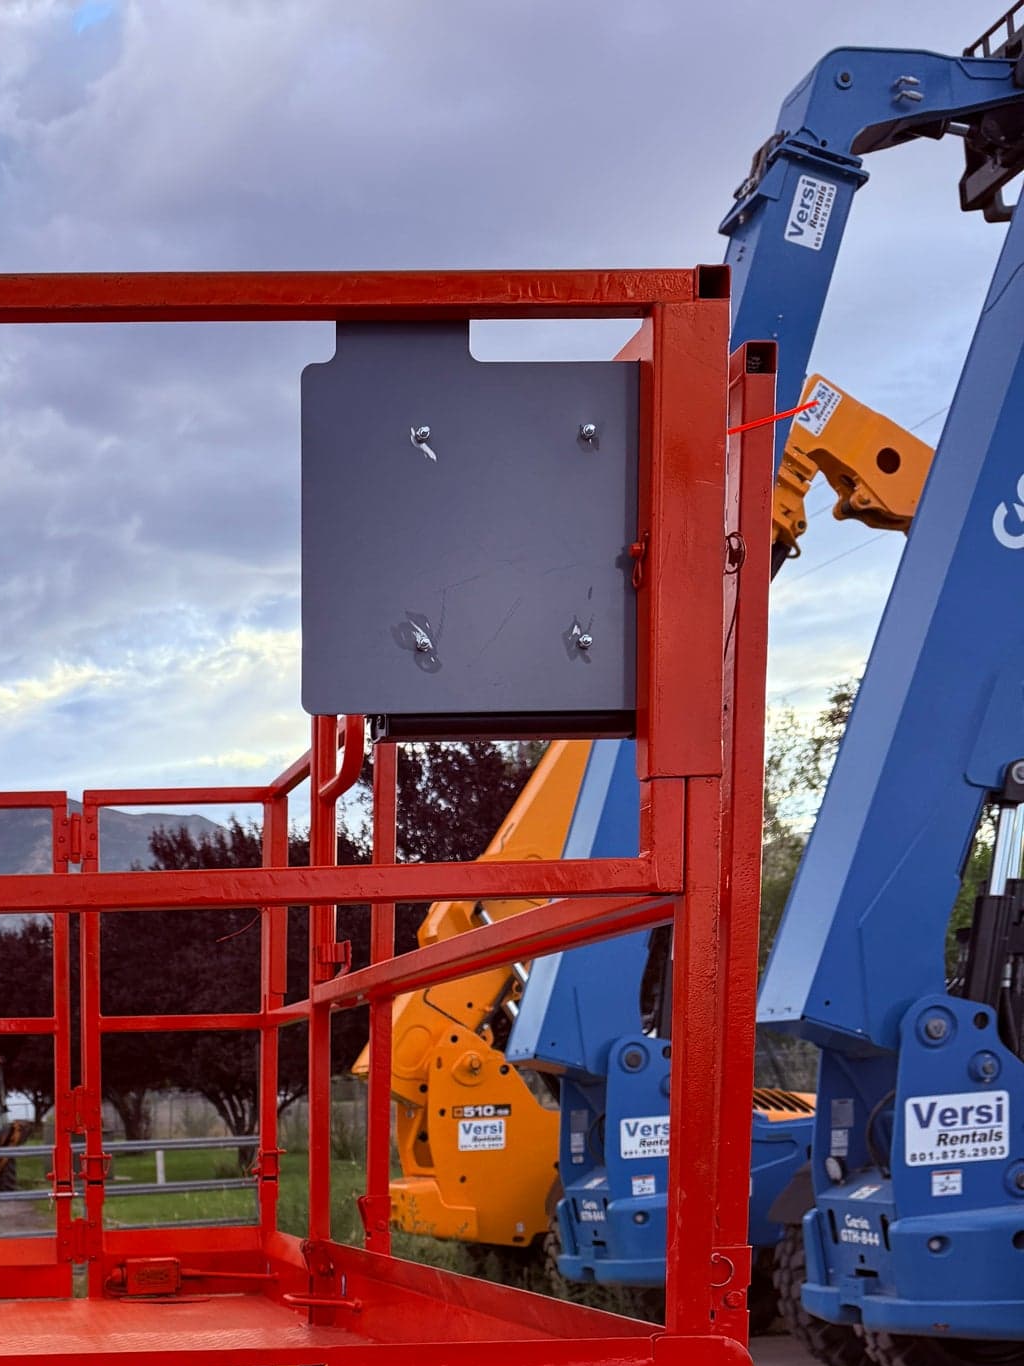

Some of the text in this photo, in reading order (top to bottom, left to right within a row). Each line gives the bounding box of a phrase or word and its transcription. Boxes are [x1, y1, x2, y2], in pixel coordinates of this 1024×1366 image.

[788, 179, 817, 238] Versi
[808, 186, 827, 229] Rentals
[798, 382, 829, 422] Vesi
[912, 1096, 1003, 1129] Versi
[461, 1121, 503, 1135] Versi
[625, 1121, 669, 1137] Vers
[639, 1138, 669, 1148] Renta
[937, 1130, 1003, 1147] Rentals
[910, 1146, 1005, 1162] 801.875.2903
[841, 1229, 880, 1246] GTH-844
